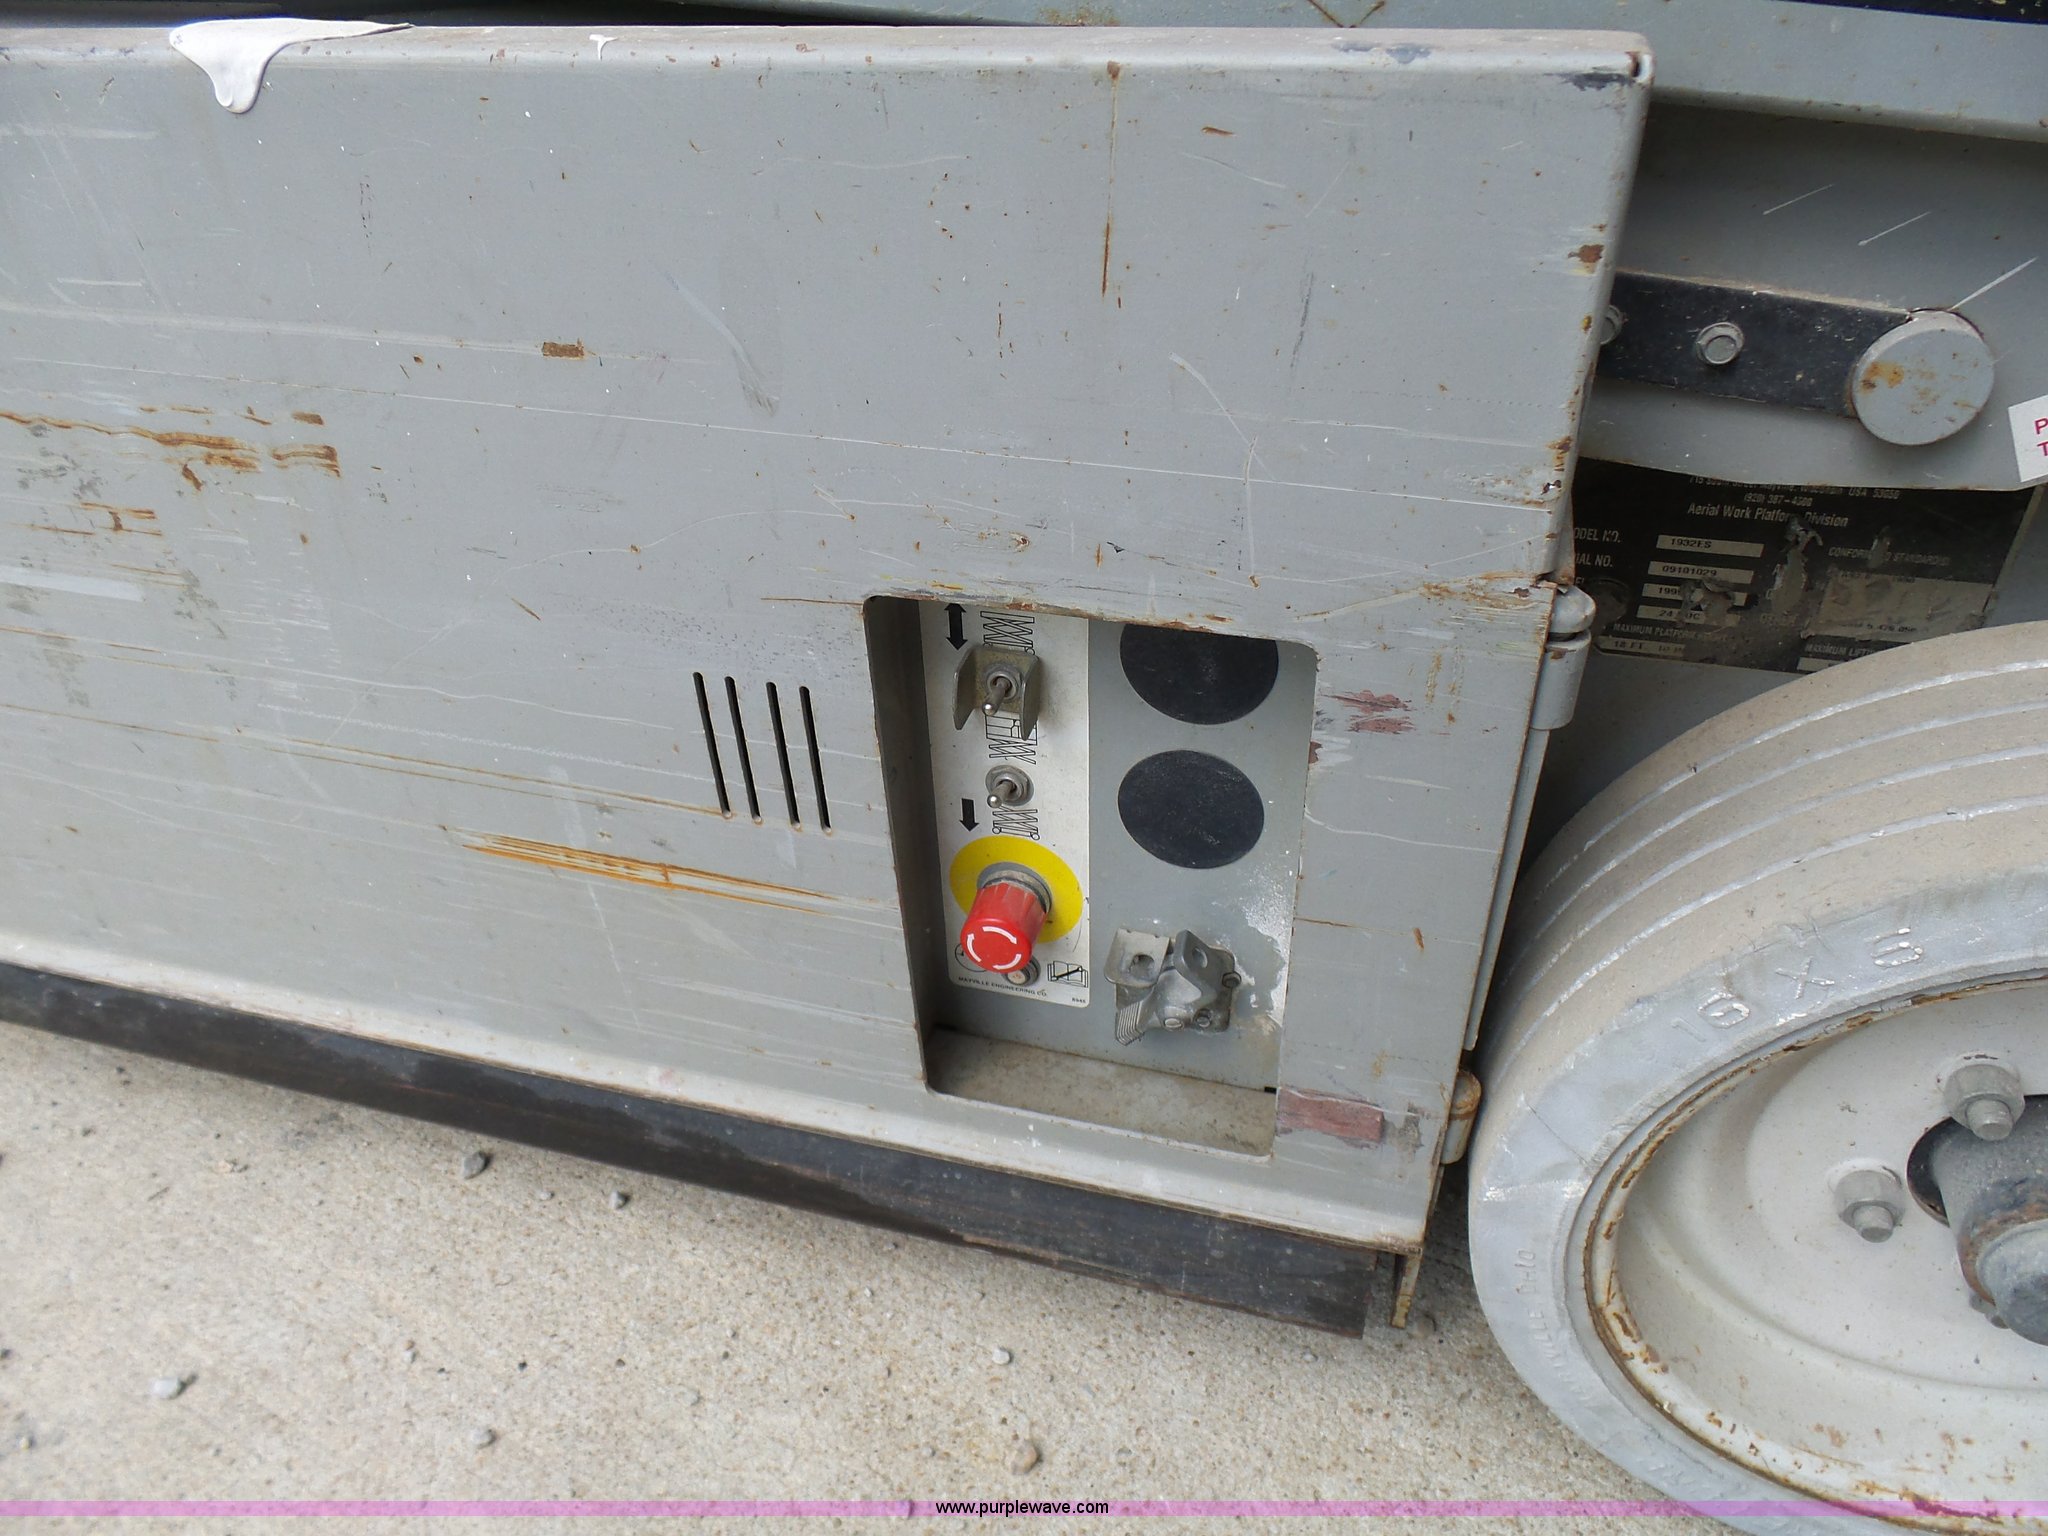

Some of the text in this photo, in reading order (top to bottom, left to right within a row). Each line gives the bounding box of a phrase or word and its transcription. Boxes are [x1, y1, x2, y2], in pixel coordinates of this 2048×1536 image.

[1687, 502, 1850, 527] Aerial Work Platfor Division
[1573, 527, 1621, 544] ODEL NO.
[1594, 554, 1614, 569] NO.
[1659, 610, 1674, 618] 24
[1613, 623, 1654, 637] MAXIMUM
[1804, 642, 1847, 657] MAXIMUM
[1775, 954, 1835, 1001] X
[1862, 925, 1925, 969] 5
[958, 976, 989, 987] MAYVILLE
[990, 982, 1036, 996] ENGINEERING
